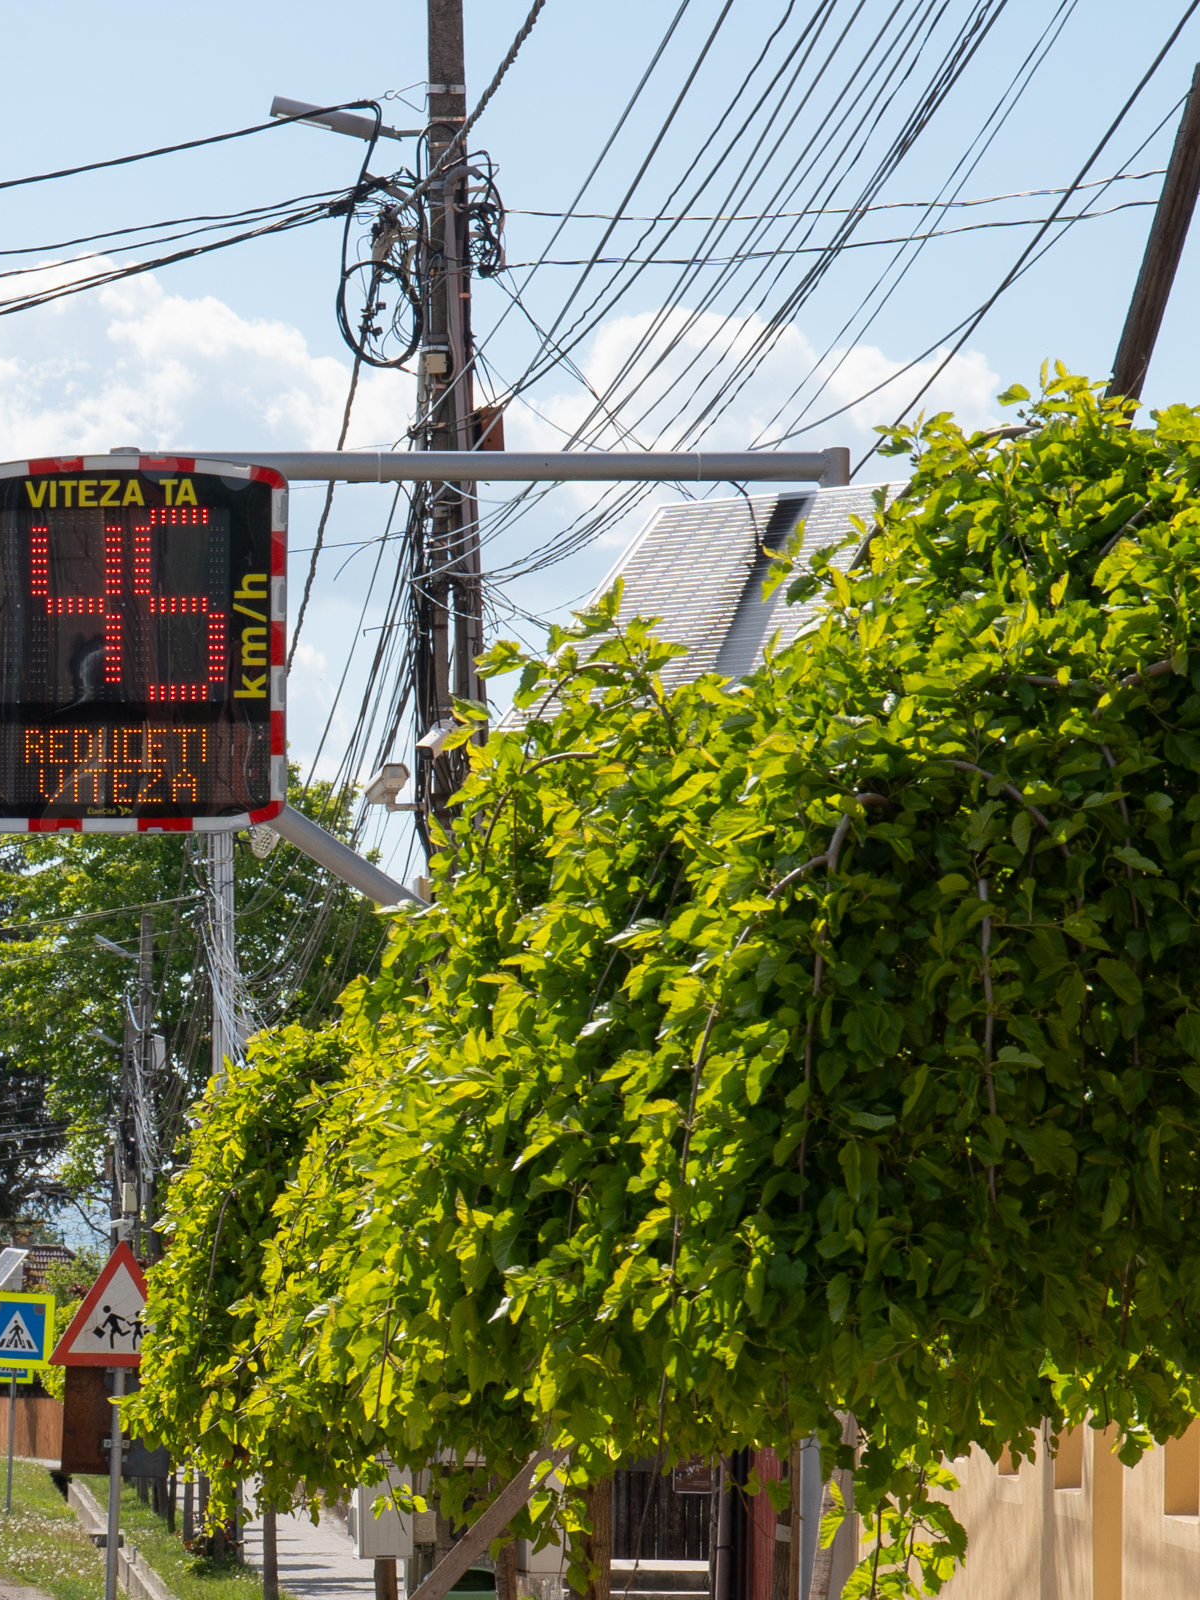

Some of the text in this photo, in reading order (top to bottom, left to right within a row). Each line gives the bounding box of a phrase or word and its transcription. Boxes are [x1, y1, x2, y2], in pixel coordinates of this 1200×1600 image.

[25, 478, 198, 508] VITEZA TA
[31, 508, 225, 701] 45
[233, 573, 268, 699] km/h
[25, 728, 207, 764] REDUCETI
[39, 768, 197, 803] VITEZA
[86, 806, 117, 815] ÉlanCité
